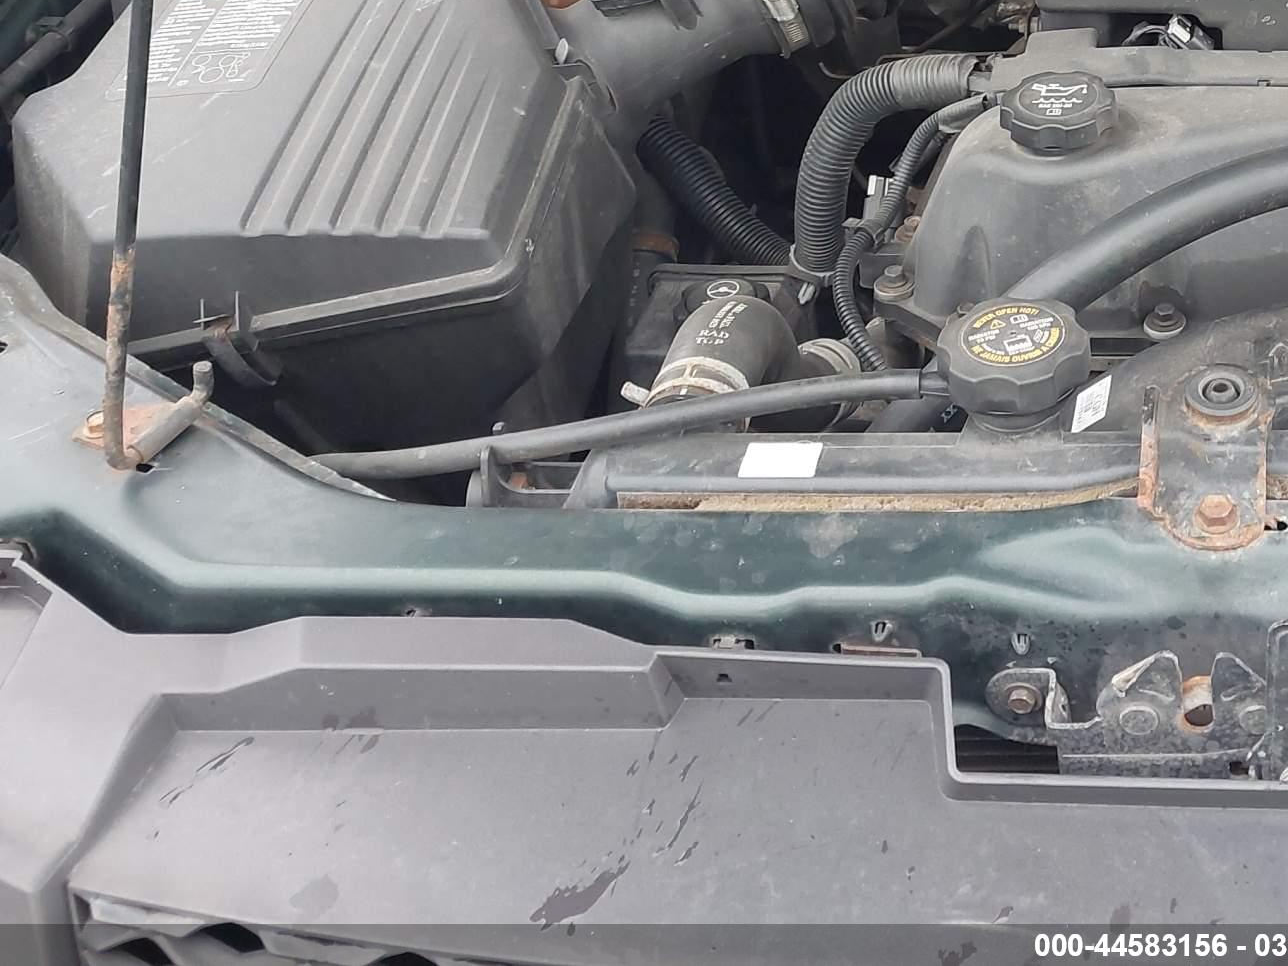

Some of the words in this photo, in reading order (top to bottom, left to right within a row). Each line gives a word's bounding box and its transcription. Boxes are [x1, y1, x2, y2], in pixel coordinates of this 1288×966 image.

[995, 306, 1018, 316] OPEN
[1018, 306, 1040, 315] HOT!
[980, 351, 1010, 363] JAMAIS
